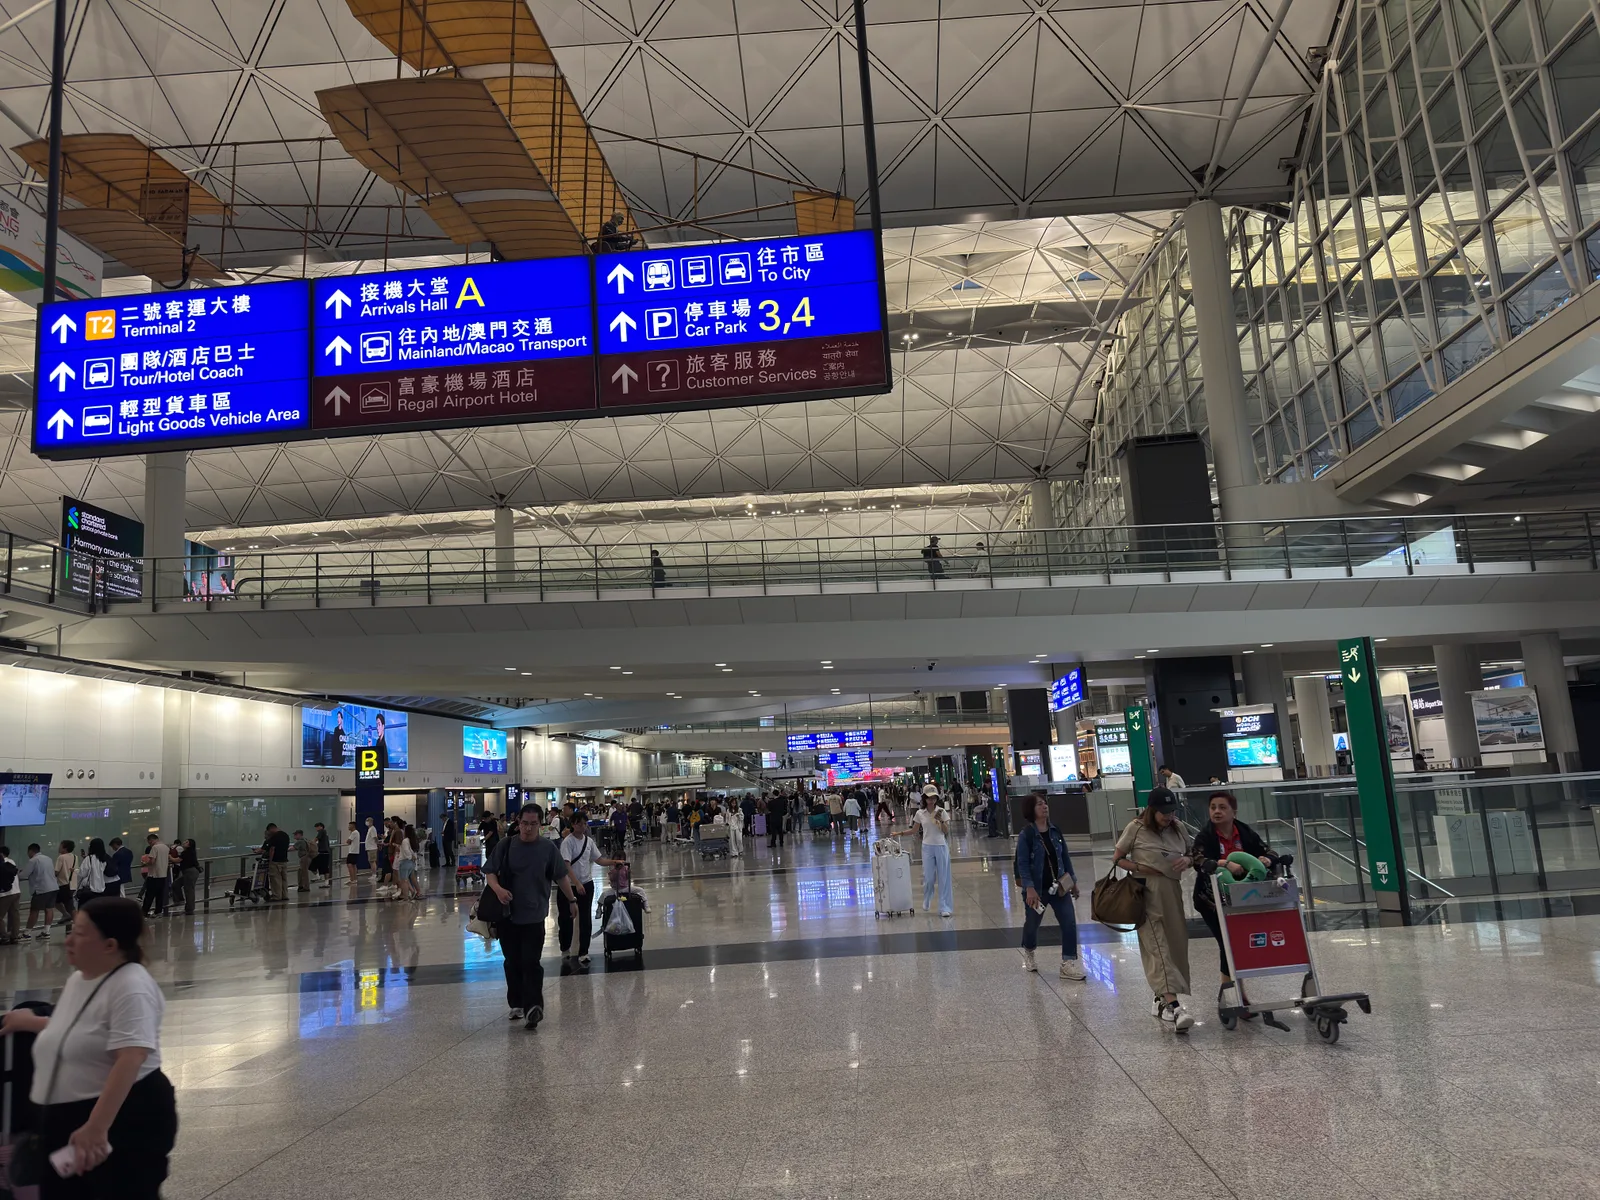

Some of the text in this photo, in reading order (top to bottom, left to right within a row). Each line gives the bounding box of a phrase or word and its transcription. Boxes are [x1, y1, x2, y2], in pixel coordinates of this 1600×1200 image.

[757, 242, 825, 268] 往市區
[758, 266, 811, 283] To City
[360, 276, 450, 303] 接機大堂
[455, 277, 486, 309] A
[121, 293, 251, 322] 二號客運大樓
[360, 297, 448, 318] Arrivals Hall
[684, 298, 752, 322] 停車場
[758, 296, 816, 335] 3,4
[88, 315, 114, 336] T2
[121, 319, 196, 338] Terminal 2
[652, 311, 673, 337] P
[685, 319, 748, 338] Car Park
[398, 335, 588, 361] Mainland/Macao Transport
[686, 348, 778, 374] 旅客服務
[121, 364, 244, 387] Tour/Hotel Coach
[397, 367, 535, 396] 富豪機場酒店
[686, 367, 817, 390] Customer Services
[119, 391, 231, 419] 輕型貨車區
[397, 389, 538, 413] Regal Airport Hotel
[118, 408, 300, 437] Light Goods Vehicle Area
[74, 536, 103, 554] Harmony
[103, 546, 125, 559] around
[114, 572, 139, 585] structure
[1242, 715, 1260, 723] DCH
[361, 749, 378, 771] B
